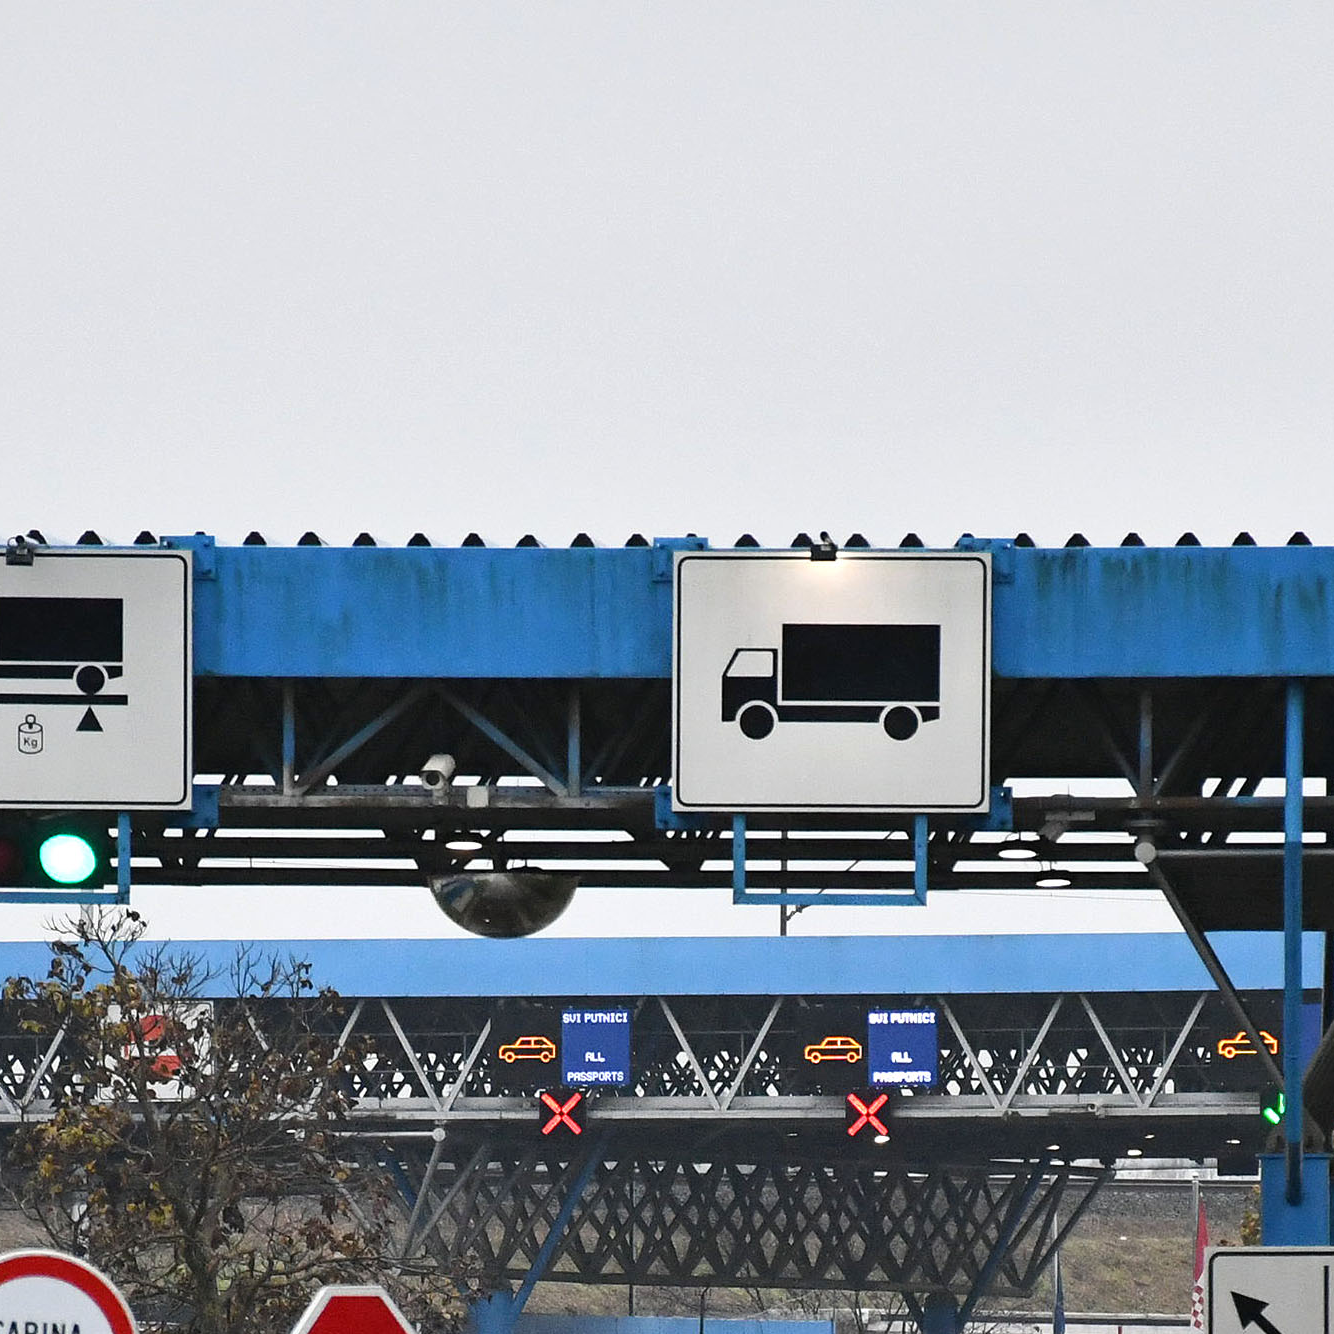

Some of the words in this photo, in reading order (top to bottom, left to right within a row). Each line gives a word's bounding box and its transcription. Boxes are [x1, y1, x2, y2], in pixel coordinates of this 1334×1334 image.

[23, 737, 38, 749] Kg
[562, 1012, 581, 1023] SVI
[584, 1012, 628, 1023] PUTNICI
[585, 1052, 605, 1062] ALL
[567, 1071, 624, 1082] PASSPORTS
